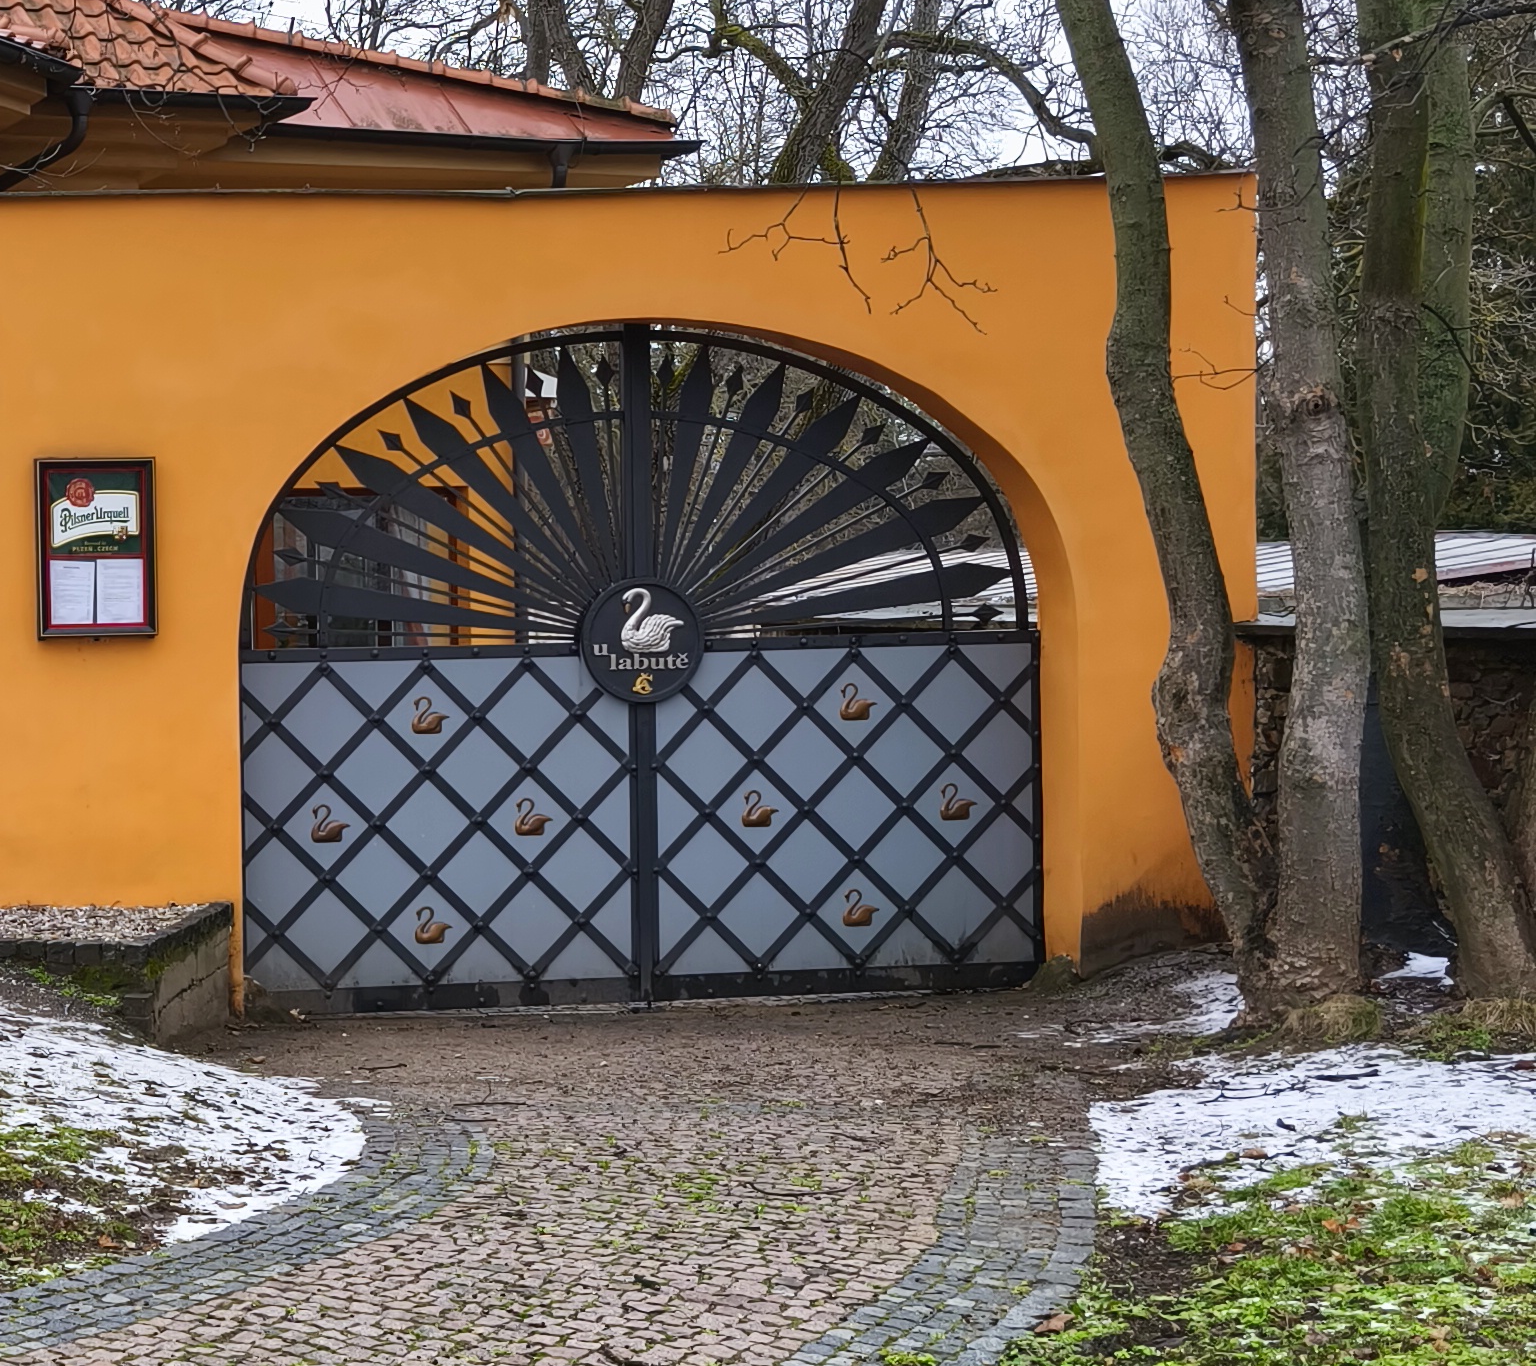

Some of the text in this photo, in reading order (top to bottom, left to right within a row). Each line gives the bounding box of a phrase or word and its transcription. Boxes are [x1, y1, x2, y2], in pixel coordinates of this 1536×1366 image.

[60, 505, 130, 533] Pilsner Urquell
[593, 643, 610, 656] u
[609, 652, 690, 671] labutě
